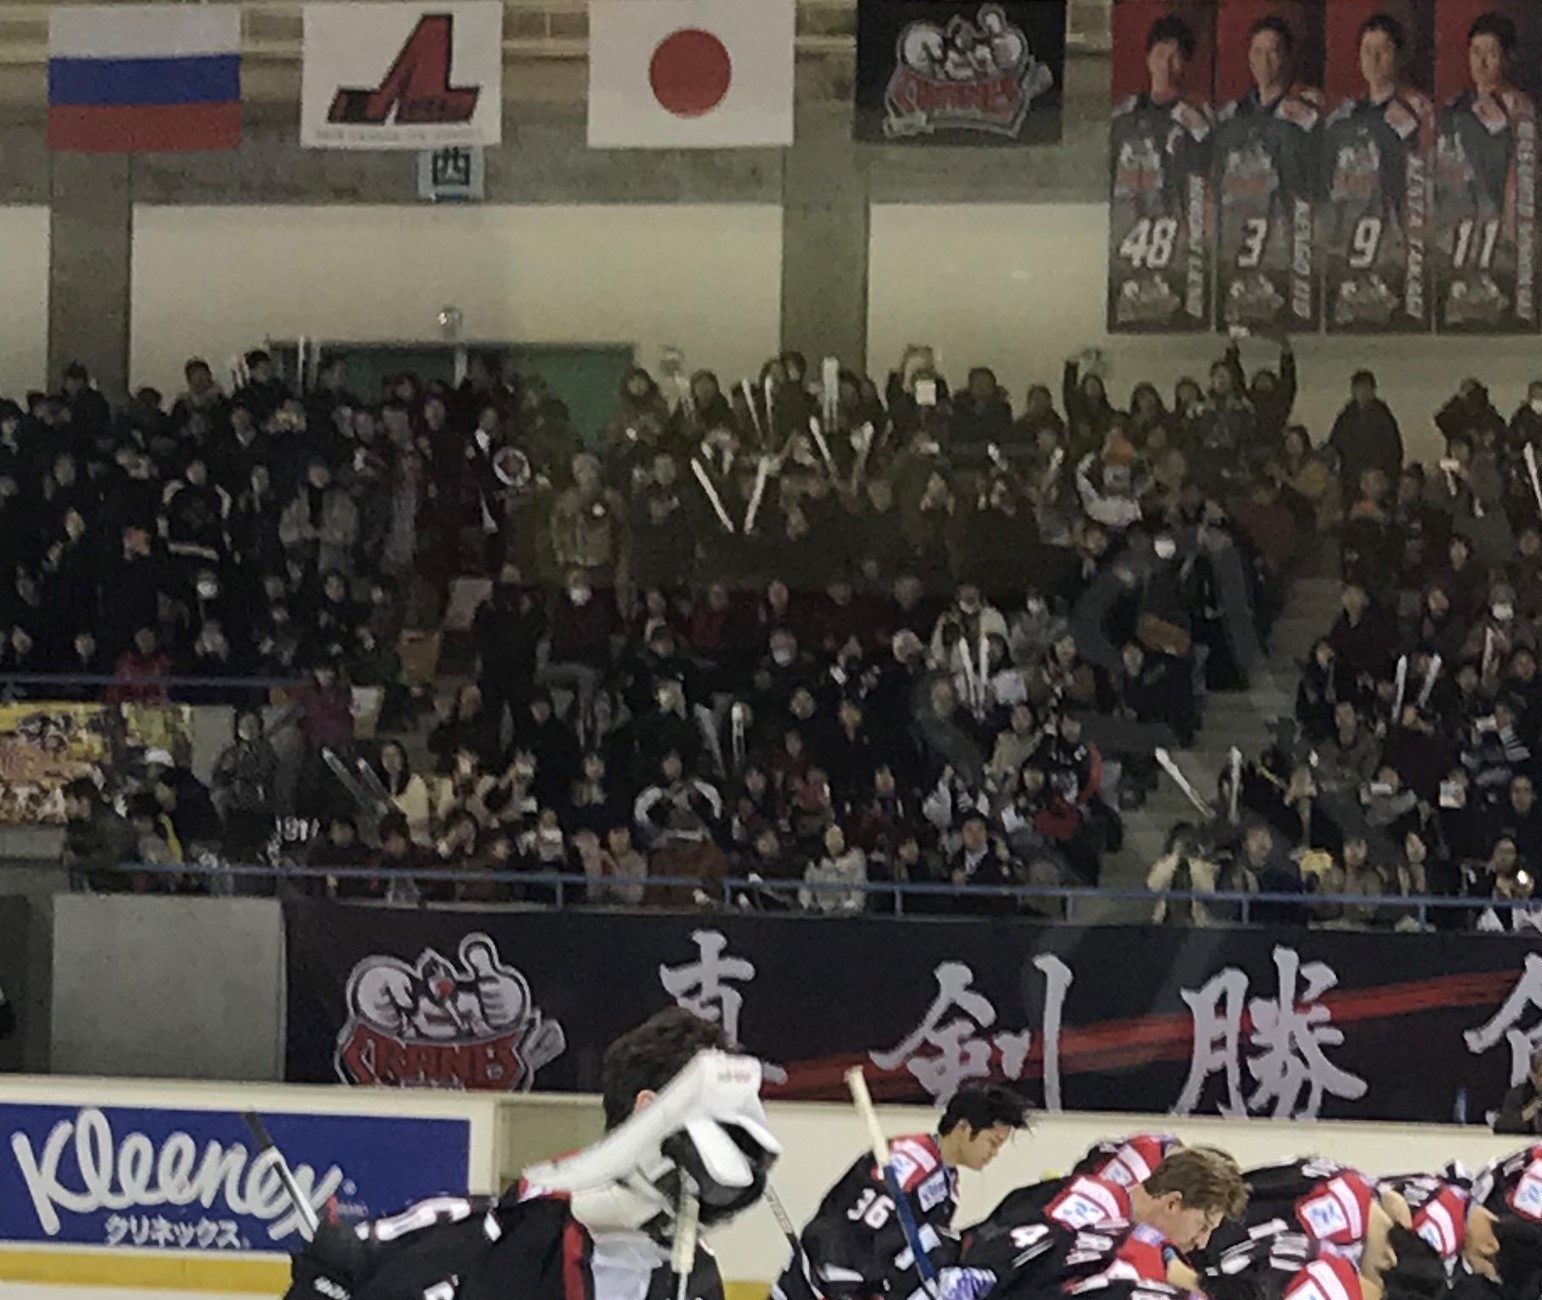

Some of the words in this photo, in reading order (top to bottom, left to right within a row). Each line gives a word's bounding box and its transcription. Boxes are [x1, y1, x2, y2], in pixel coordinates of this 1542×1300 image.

[1117, 217, 1177, 269] 48
[1236, 217, 1268, 268] 3
[1348, 217, 1381, 269] 9
[1452, 218, 1498, 268] 11
[105, 1213, 242, 1248] クリネックス
